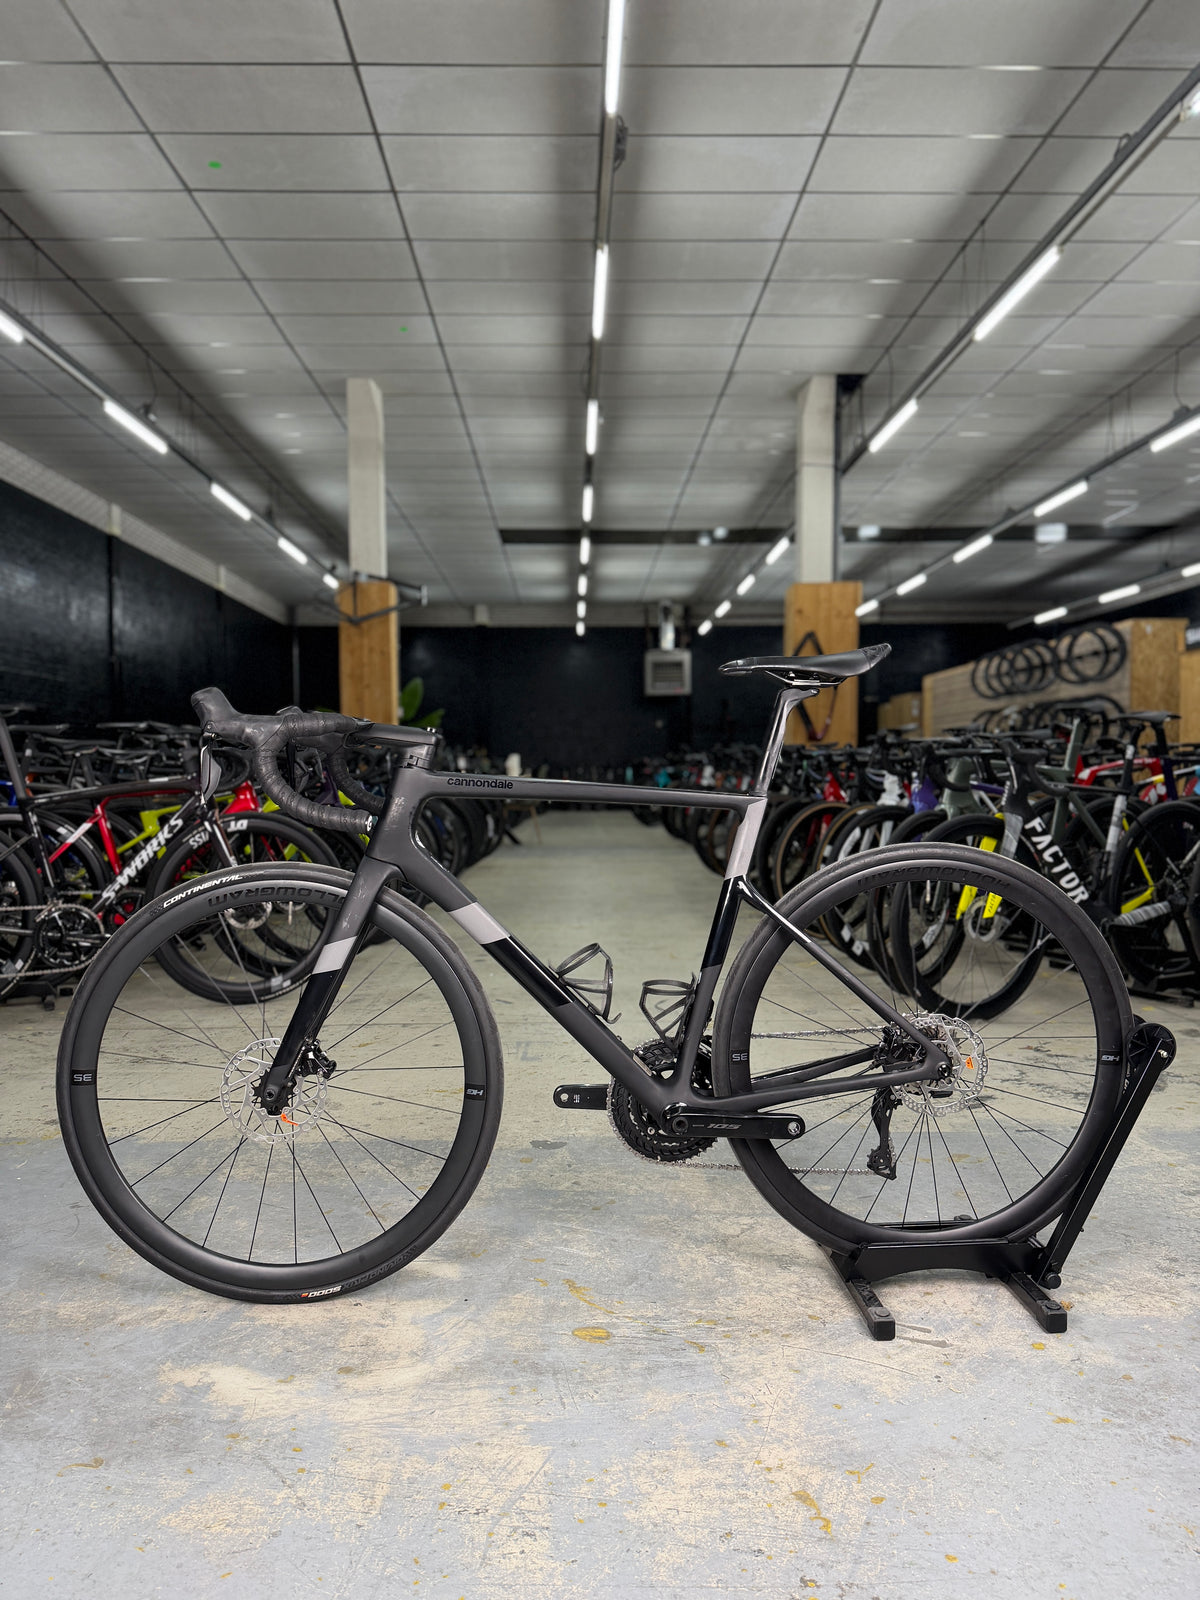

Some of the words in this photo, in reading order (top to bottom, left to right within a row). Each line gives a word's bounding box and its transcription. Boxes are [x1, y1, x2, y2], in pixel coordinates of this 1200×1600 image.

[447, 777, 513, 789] cannondale
[101, 818, 184, 907] S-WORKS
[1024, 817, 1089, 904] FACTOR
[163, 873, 243, 909] CONTINENTAL
[208, 886, 344, 907] LLOWGRAM
[307, 1286, 342, 1298] 5000
